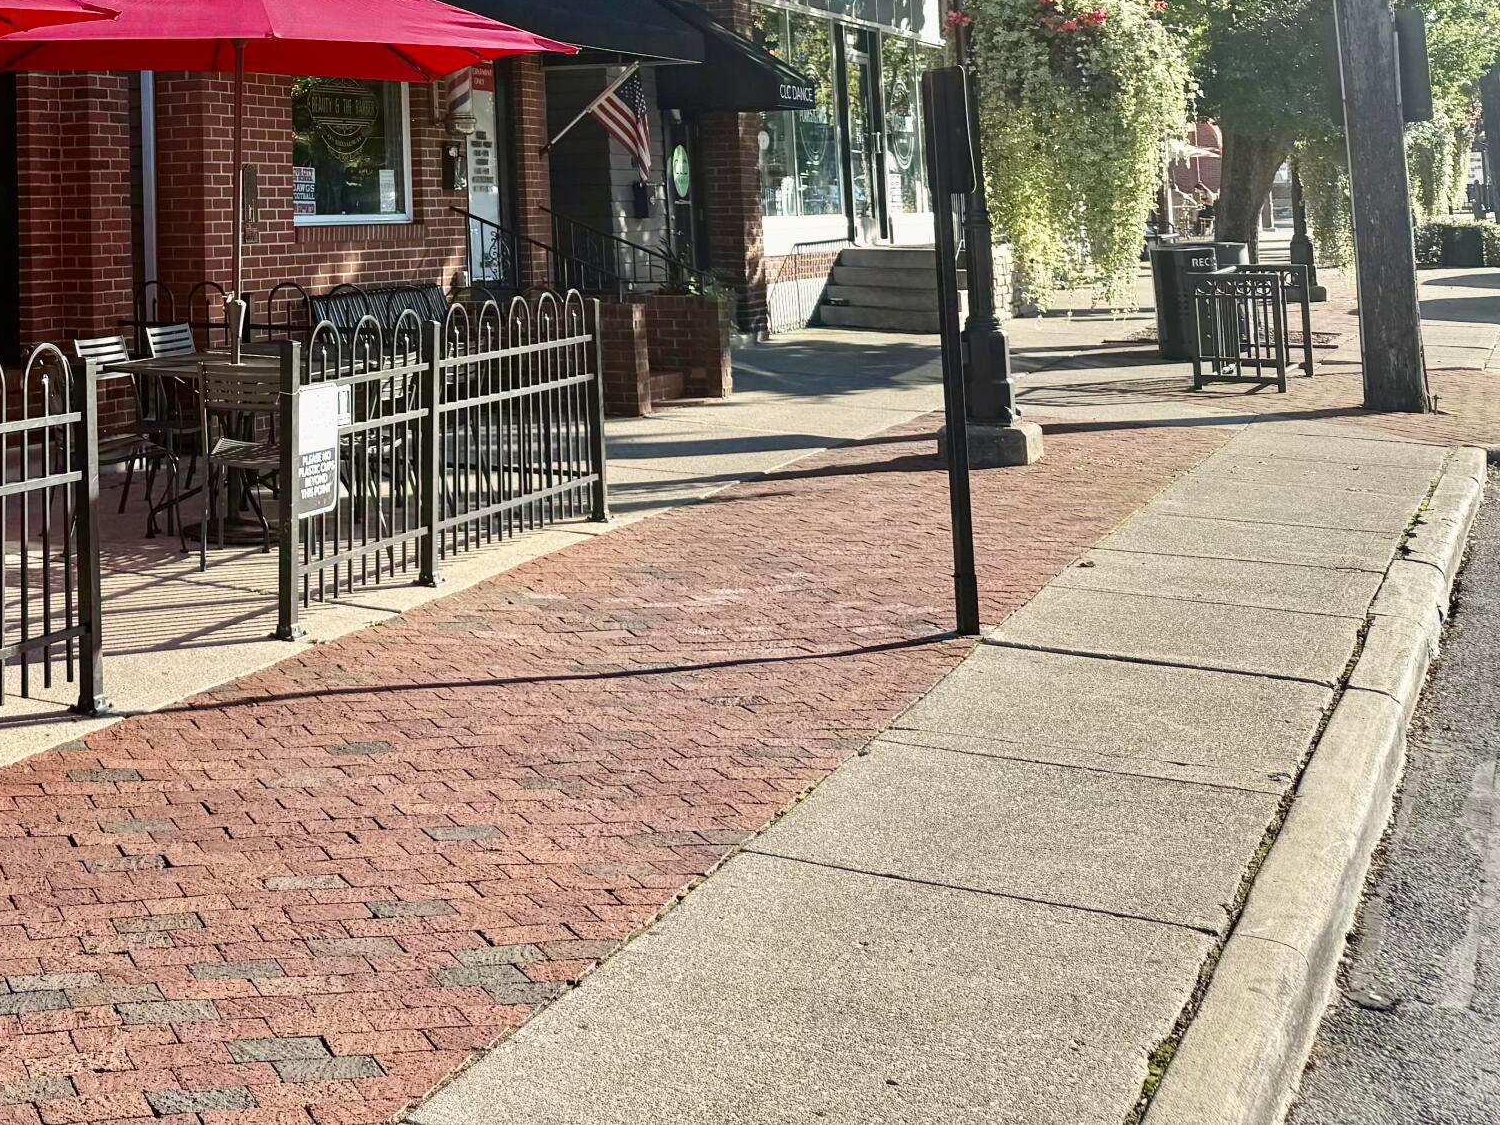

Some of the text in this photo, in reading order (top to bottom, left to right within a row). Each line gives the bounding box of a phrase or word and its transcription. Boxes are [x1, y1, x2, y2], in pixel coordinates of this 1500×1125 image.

[792, 86, 814, 102] DANCE
[311, 96, 332, 113] BEAUTY
[343, 98, 352, 115] THE
[1191, 257, 1214, 267] REC
[302, 450, 331, 466] PLEASE NO
[298, 460, 335, 478] PLASTIC CUPS
[304, 473, 328, 488] BEYOND
[300, 482, 332, 499] THIS POINT
